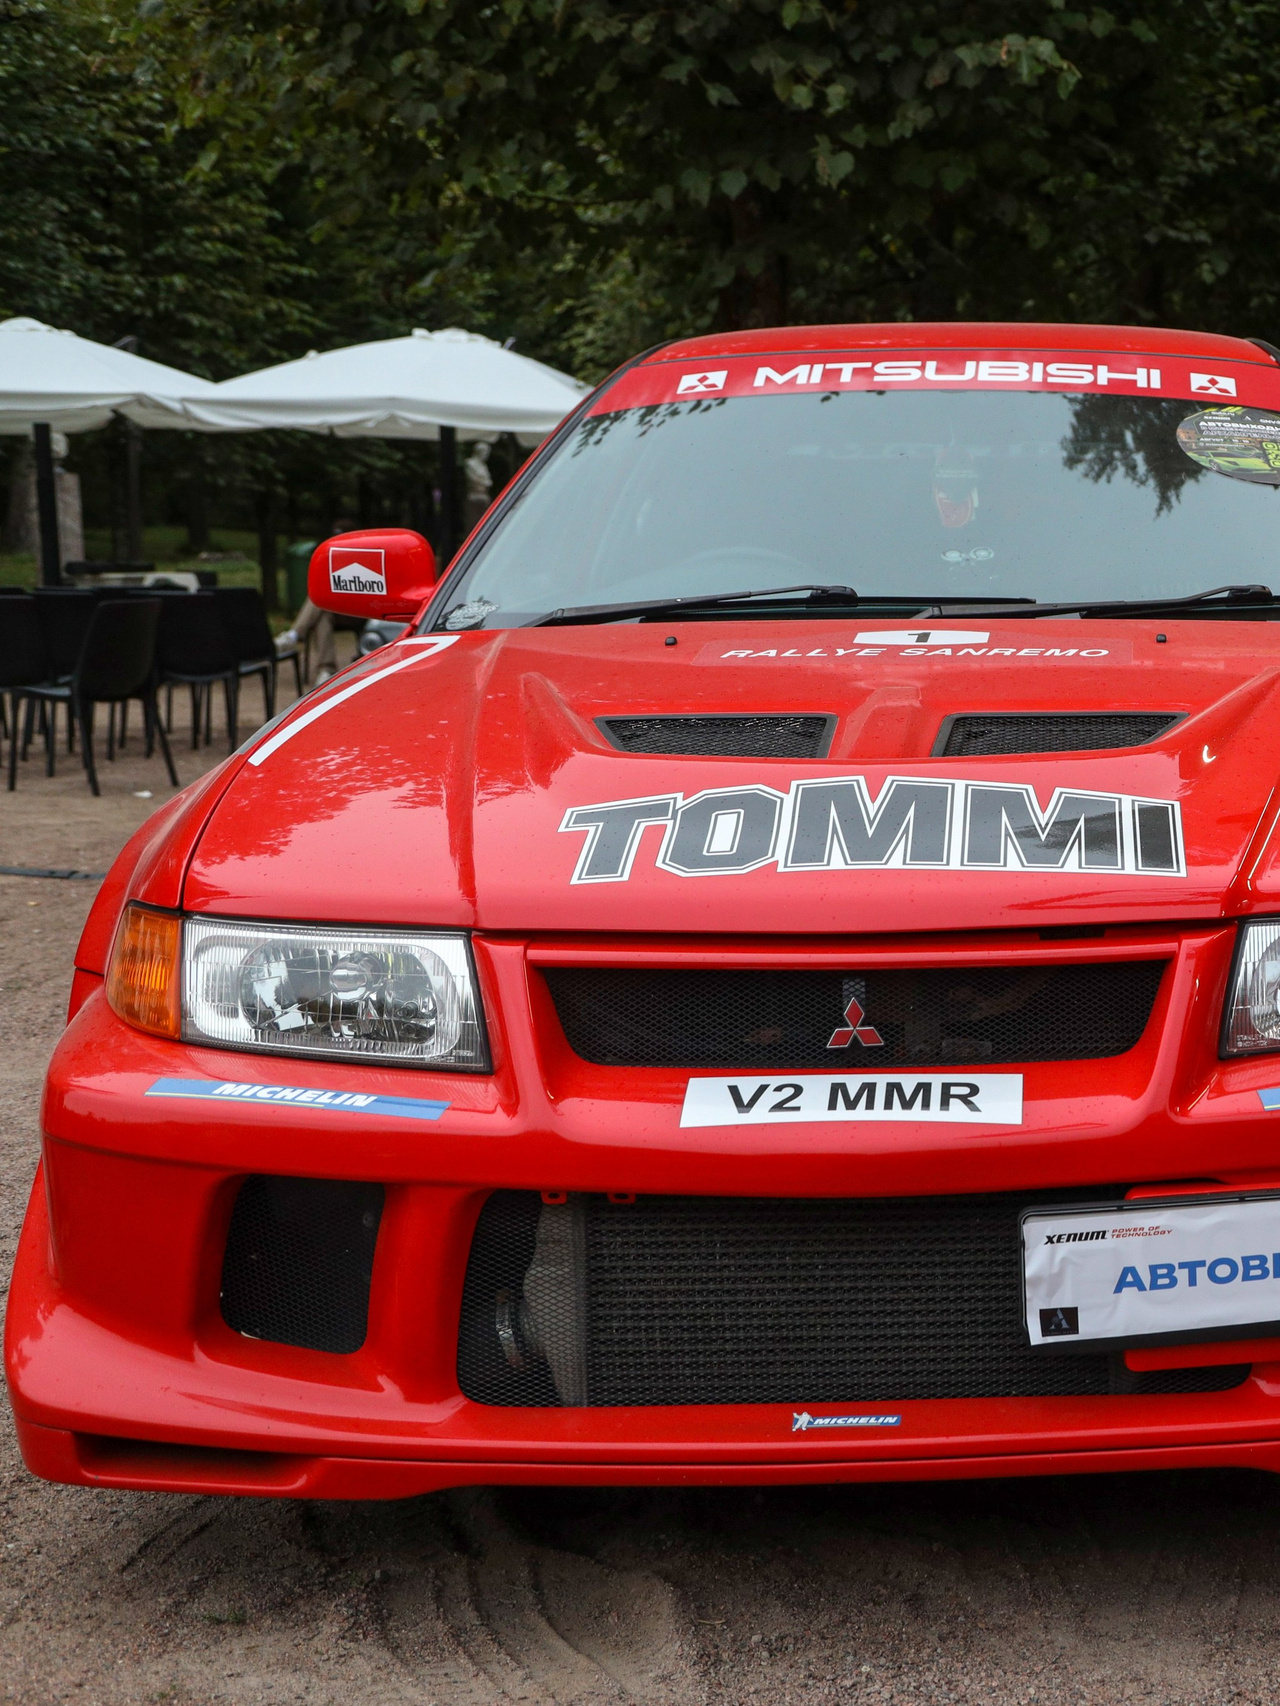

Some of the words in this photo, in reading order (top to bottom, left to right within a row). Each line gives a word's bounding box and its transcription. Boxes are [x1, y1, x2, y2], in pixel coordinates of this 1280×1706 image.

[753, 361, 1161, 389] MITSUBISHI
[332, 575, 384, 593] Marlboro
[907, 632, 932, 643] 1
[720, 647, 887, 658] RALLYE
[899, 648, 1110, 658] SANREMO
[557, 775, 1188, 885] TOMMI
[212, 1083, 377, 1107] MICHELIN
[727, 1083, 804, 1114] V2
[827, 1082, 982, 1112] MMR
[1111, 1229, 1172, 1239] TECHNOLOGY
[813, 1416, 898, 1425] MICHELIN
